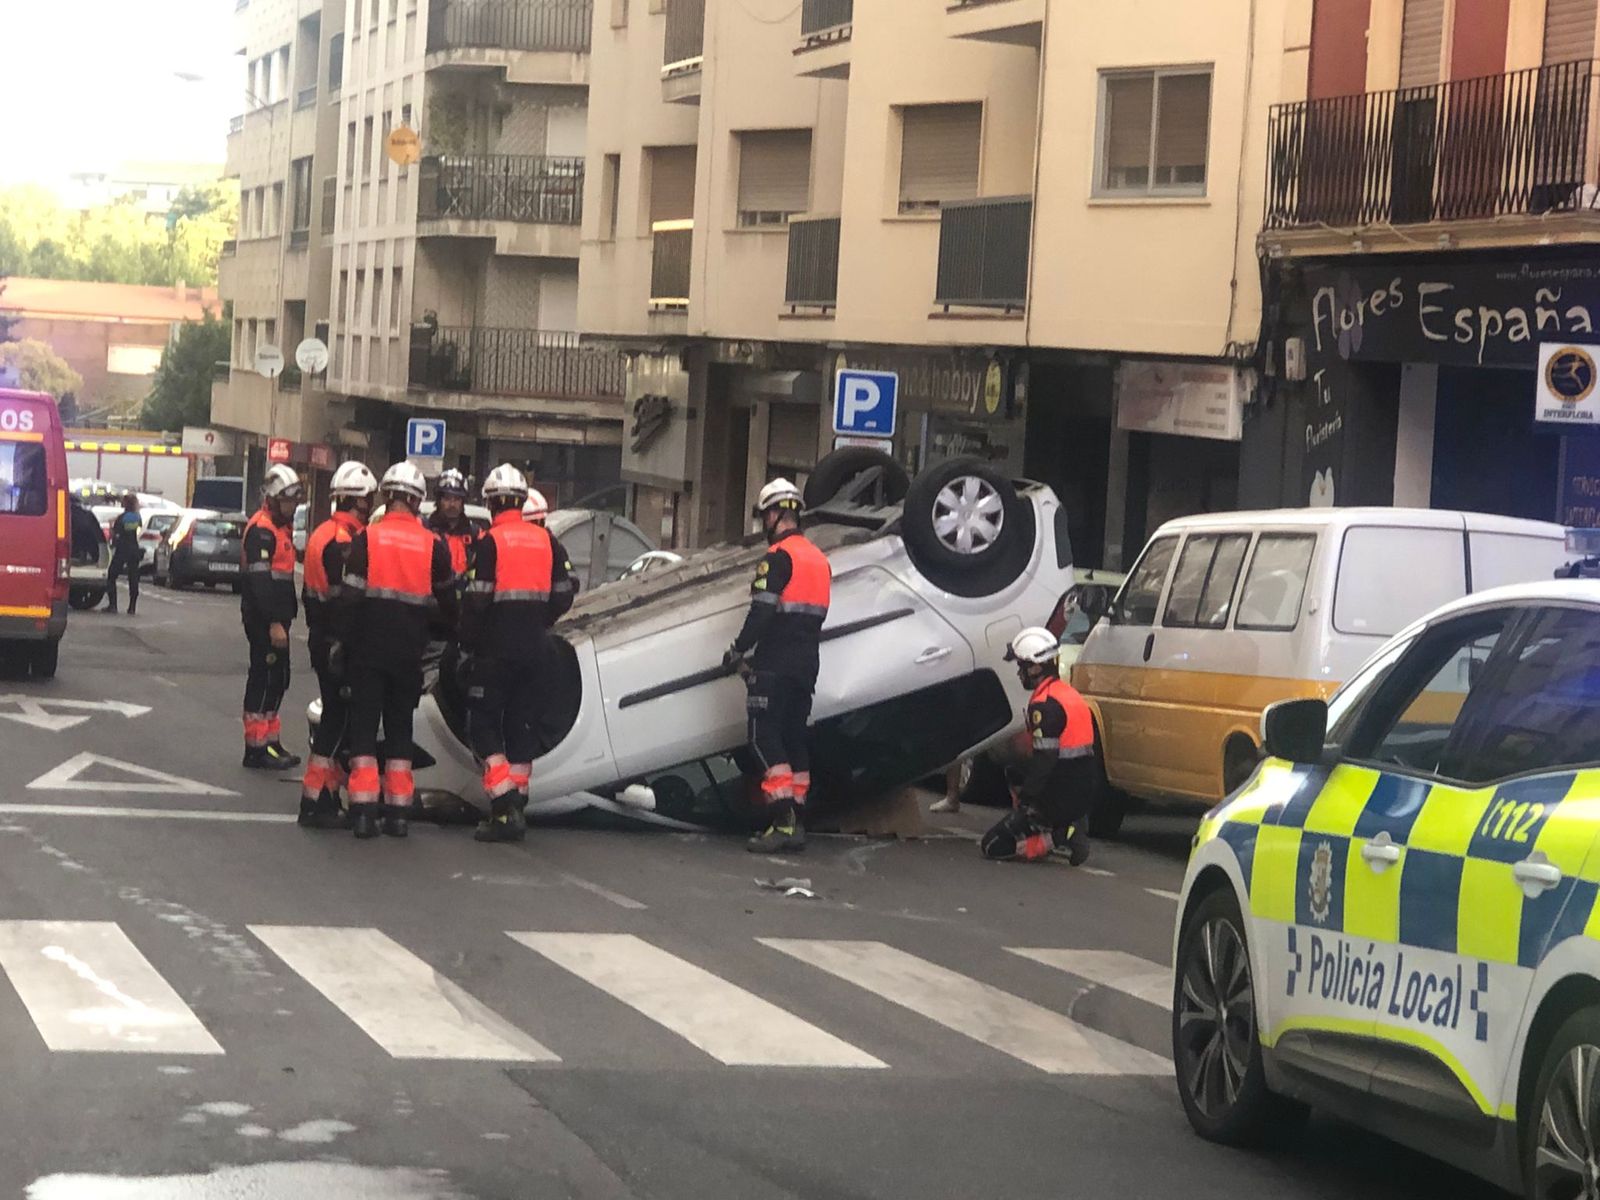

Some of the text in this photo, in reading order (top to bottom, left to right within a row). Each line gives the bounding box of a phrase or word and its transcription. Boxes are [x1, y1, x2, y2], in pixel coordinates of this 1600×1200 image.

[1417, 281, 1593, 365] España
[842, 377, 881, 428] P
[415, 423, 438, 453] P
[1491, 799, 1545, 843] 112
[1307, 934, 1463, 1029] Policía Local
